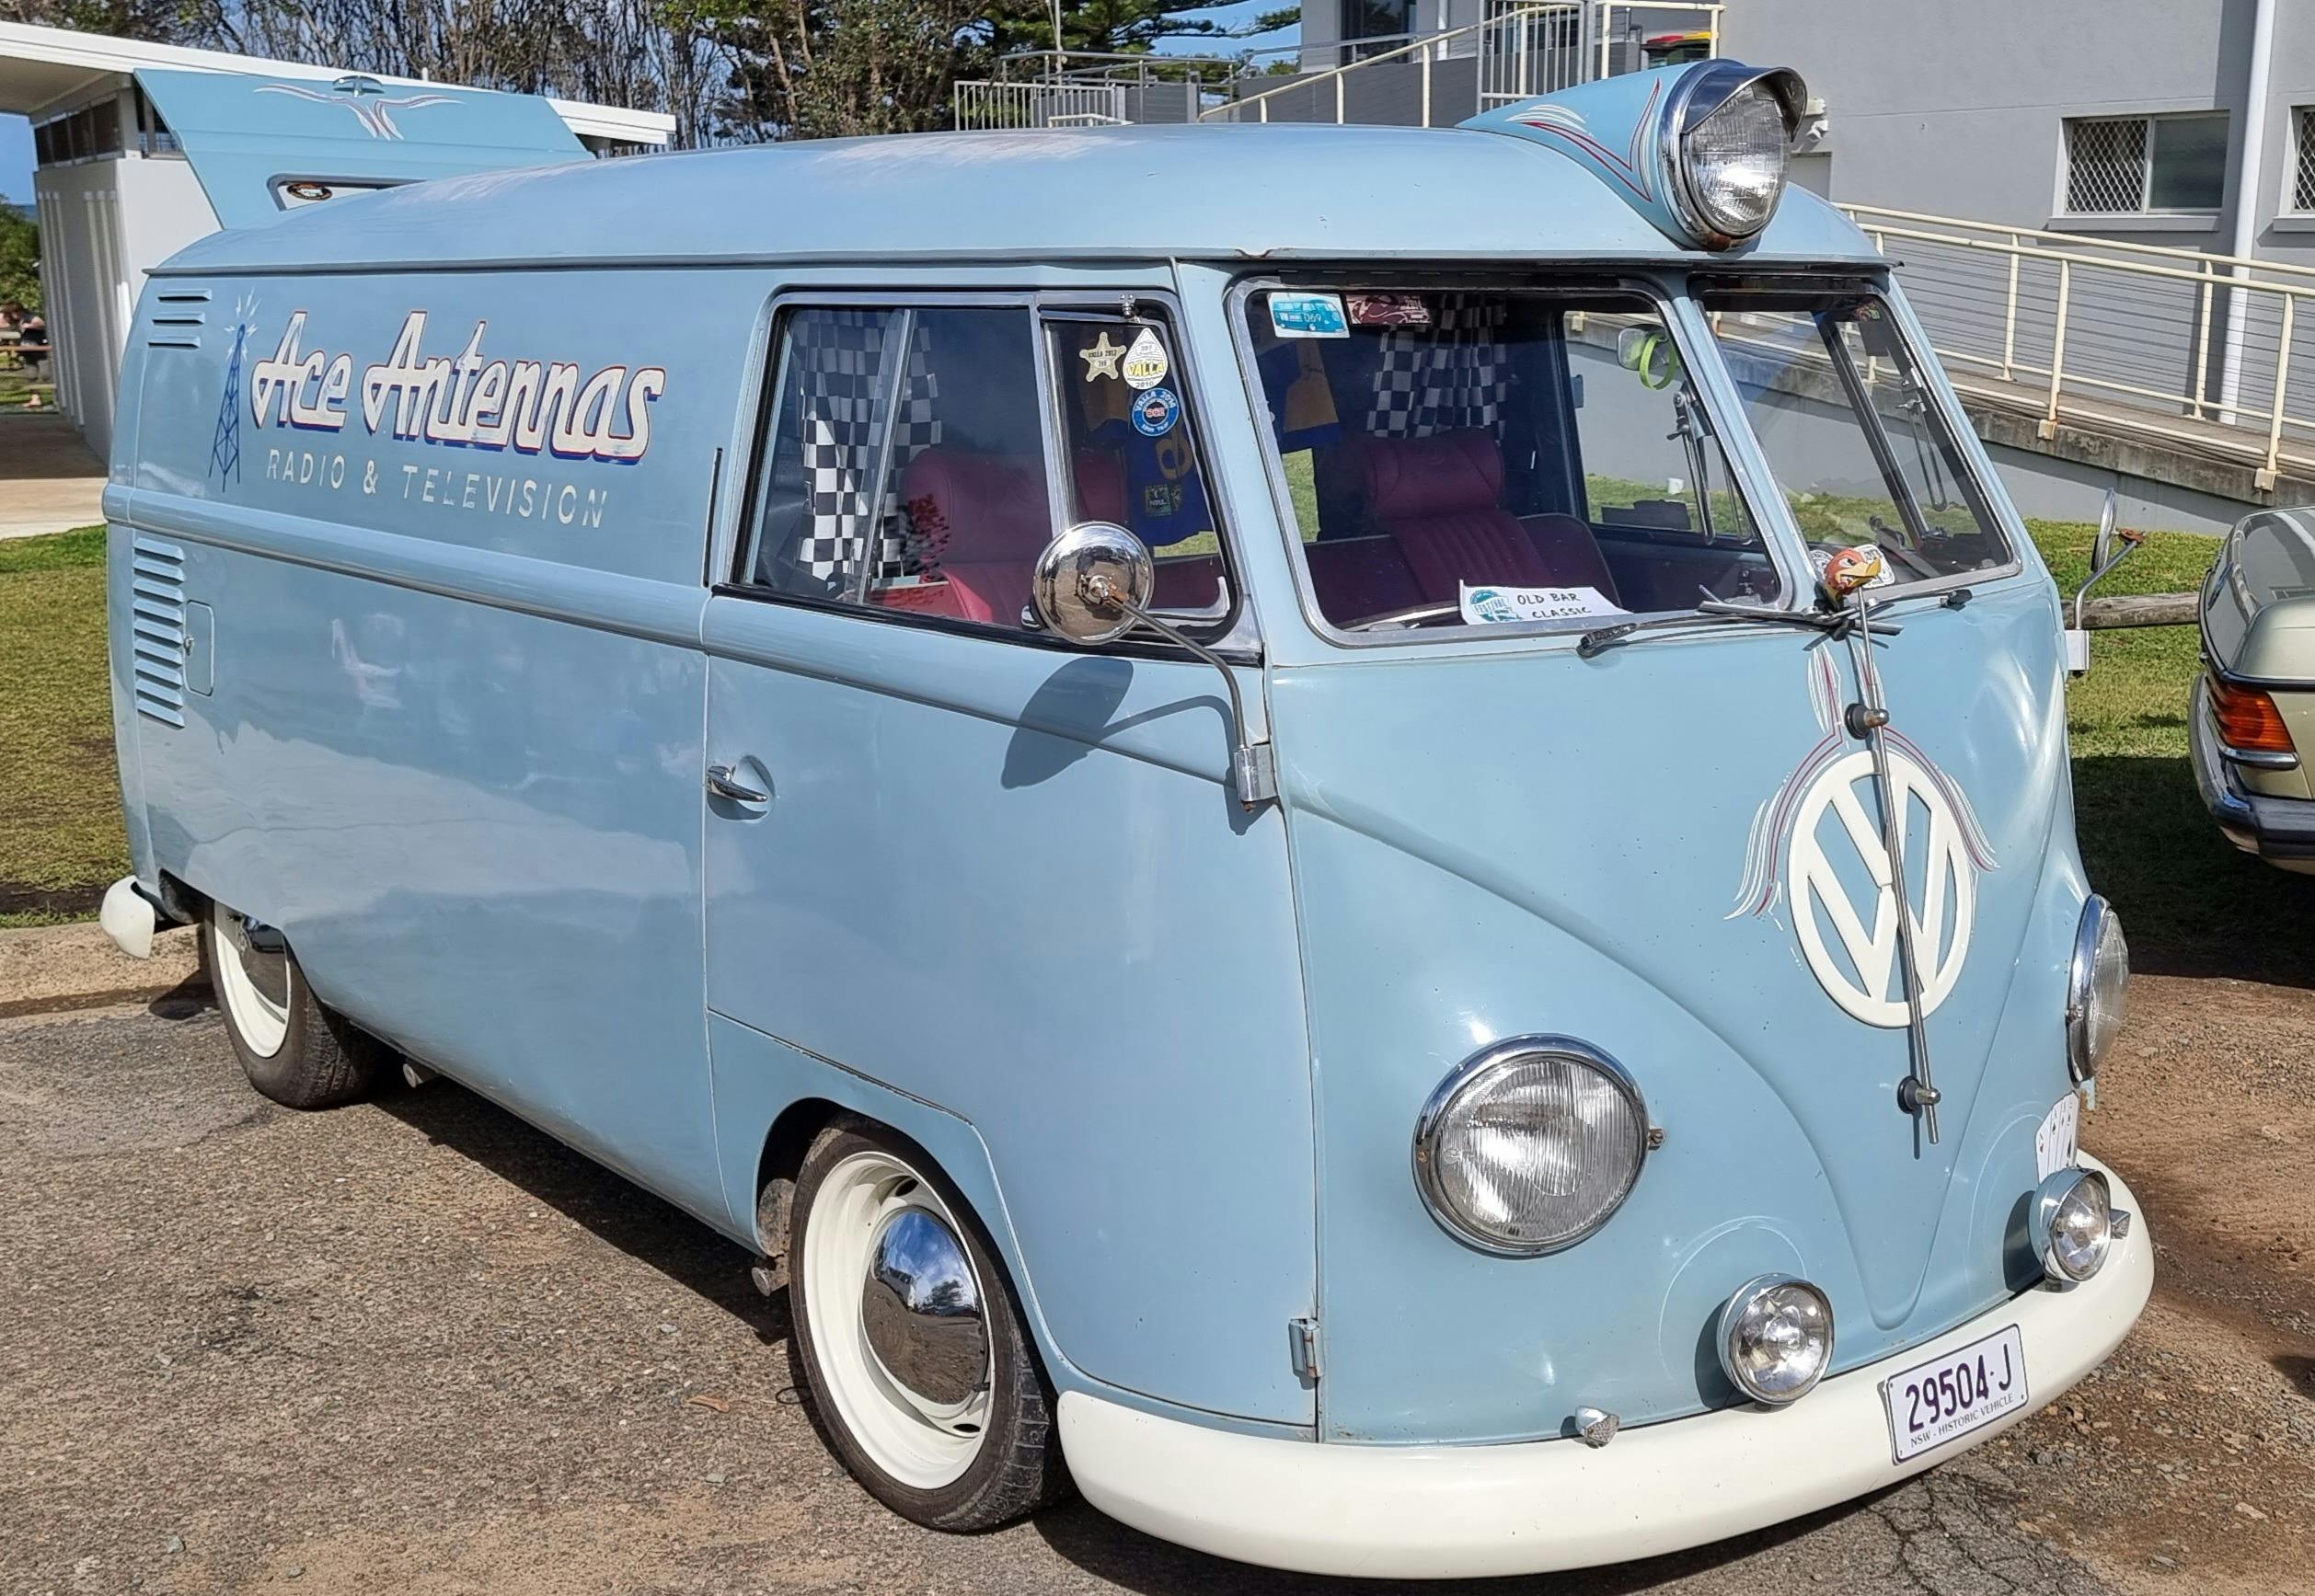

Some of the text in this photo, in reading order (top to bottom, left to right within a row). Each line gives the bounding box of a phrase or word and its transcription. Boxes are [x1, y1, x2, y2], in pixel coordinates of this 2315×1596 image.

[1126, 362, 1165, 377] VALLA
[250, 310, 667, 465] Ace Antennas
[1134, 390, 1157, 412] VALLA
[266, 449, 607, 529] RADIO & TELEVISION
[1516, 592, 1582, 605] OLD BAR
[1531, 606, 1592, 619] CLASSIC
[1910, 1431, 1931, 1448] NSW
[1938, 1410, 1979, 1436] HISTORIC
[1979, 1394, 2014, 1417] VEHICLE
